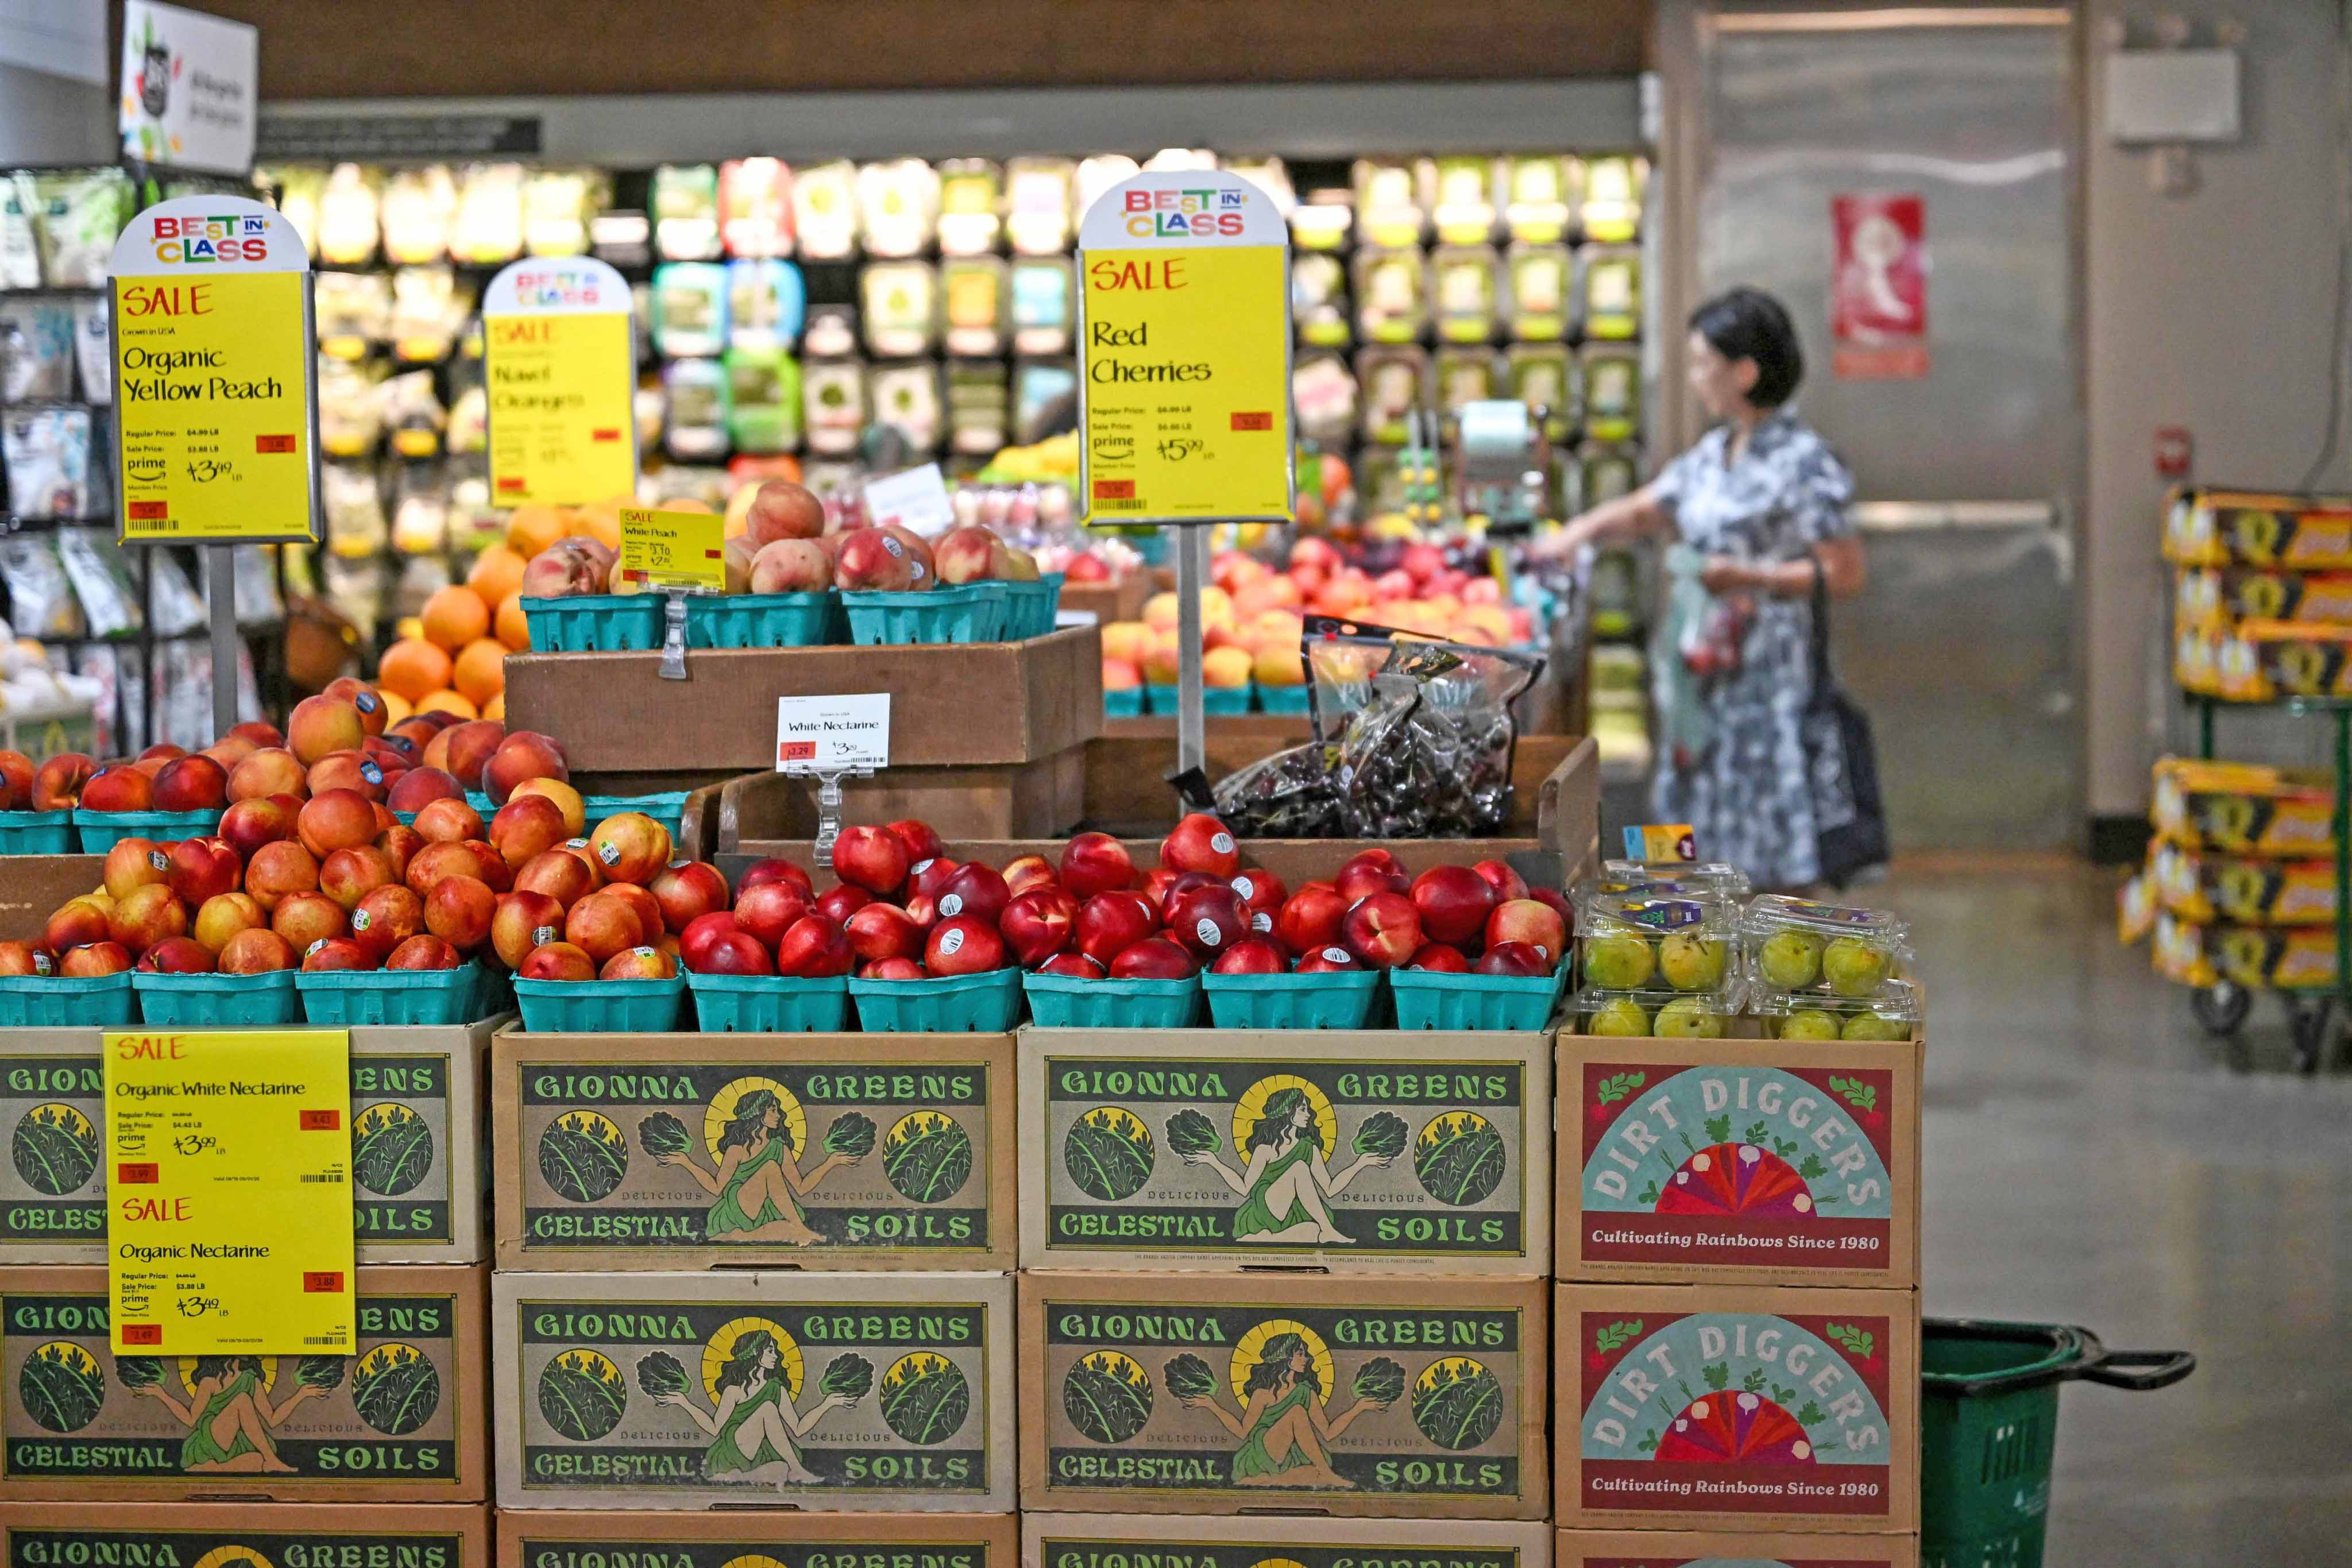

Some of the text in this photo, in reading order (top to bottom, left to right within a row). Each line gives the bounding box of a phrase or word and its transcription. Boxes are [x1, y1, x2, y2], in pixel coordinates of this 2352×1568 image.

[1125, 190, 1240, 213] BEST IN
[154, 215, 263, 240] BEST IN
[1126, 213, 1244, 238] CLASS
[156, 239, 267, 262] CLASS
[1091, 257, 1188, 291] SALE
[123, 283, 213, 316] SALE
[495, 319, 558, 343] SALE
[1094, 321, 1147, 347] Red
[124, 347, 226, 375] Organic
[1091, 358, 1212, 384] Cherries
[125, 377, 282, 402] Yellow Peach
[1094, 434, 1134, 450] prime
[128, 457, 165, 470] prime
[625, 511, 653, 523] SALE
[625, 527, 677, 538] White Peach
[789, 721, 879, 731] White Nectarine
[117, 1035, 188, 1060] SALE
[8, 1068, 102, 1091] GION
[116, 1081, 307, 1100] Organic White Nectarine
[534, 1074, 973, 1099] GIONNA GREENS
[1060, 1070, 1507, 1100] GIONNA GREENS
[118, 1133, 145, 1143] prime
[1594, 1077, 1880, 1206] DIRT DIGGERS
[622, 1191, 703, 1201] DELICIOUS
[813, 1192, 894, 1202] DELICIOUS
[1149, 1191, 1230, 1200] DELICIOUS
[1343, 1193, 1426, 1203] DELICIOUS
[122, 1197, 194, 1222] SALE
[534, 1215, 972, 1239] CELESTIAL SOILS
[1059, 1213, 1504, 1242] CELESTIAL SOILS
[1592, 1230, 1879, 1251] Cultivating Rainbows Since 1980
[120, 1243, 270, 1263] Organic Nectarine
[121, 1295, 149, 1304] prime
[15, 1306, 109, 1330] GION
[534, 1314, 970, 1341] GIONNA GREENS
[1060, 1315, 1505, 1346] GIONNA GREENS
[1592, 1323, 1880, 1451] DIRT DIGGERS
[99, 1423, 177, 1432] DELICIOUS
[284, 1423, 364, 1433] DELICIOUS
[621, 1431, 700, 1440] DELICIOUS
[810, 1432, 891, 1443] DELICIOUS
[1147, 1434, 1228, 1444] DELICIOUS
[1341, 1437, 1423, 1447] DELICIOUS
[16, 1445, 439, 1470] CELESTIAL SOILS
[534, 1454, 969, 1480] CELESTIAL SOILS
[1059, 1455, 1503, 1486] CELESTIAL SOILS
[1592, 1478, 1879, 1497] Cultivating Rainbows Since 1980
[23, 1542, 446, 1568] GIONNA GREENS
[536, 1552, 695, 1568] GIONNA
[1057, 1552, 1218, 1568] GIONNA
